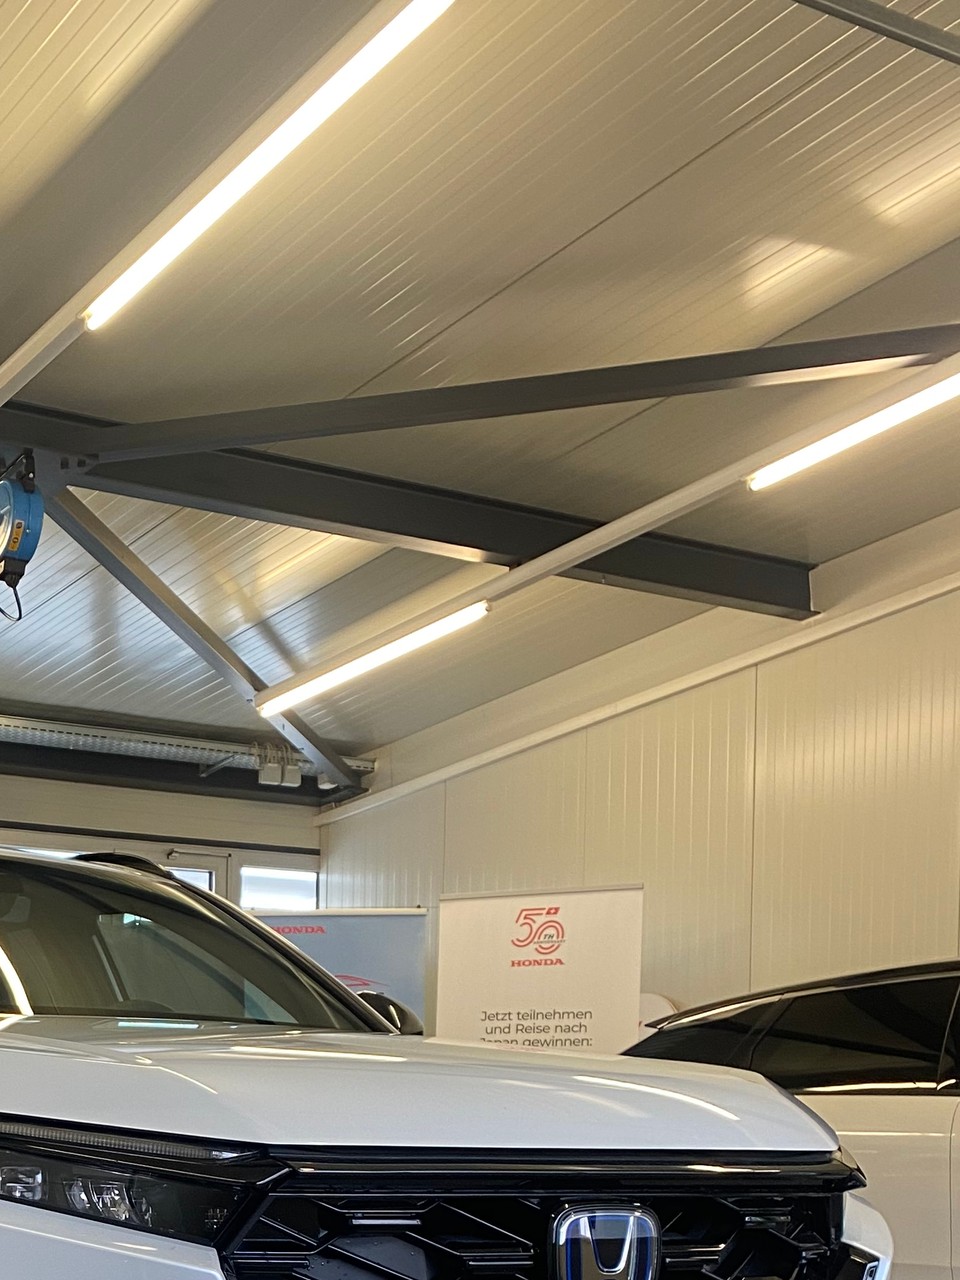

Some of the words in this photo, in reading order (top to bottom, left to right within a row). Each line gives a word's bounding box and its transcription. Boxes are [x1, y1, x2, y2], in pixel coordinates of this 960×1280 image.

[511, 958, 565, 968] HONDA
[480, 1010, 513, 1022] Jetzt
[516, 1009, 593, 1021] teilnehmen
[485, 1023, 512, 1035] und
[515, 1022, 551, 1034] Reise
[554, 1022, 588, 1034] nach
[522, 1036, 593, 1048] gewinnen:
